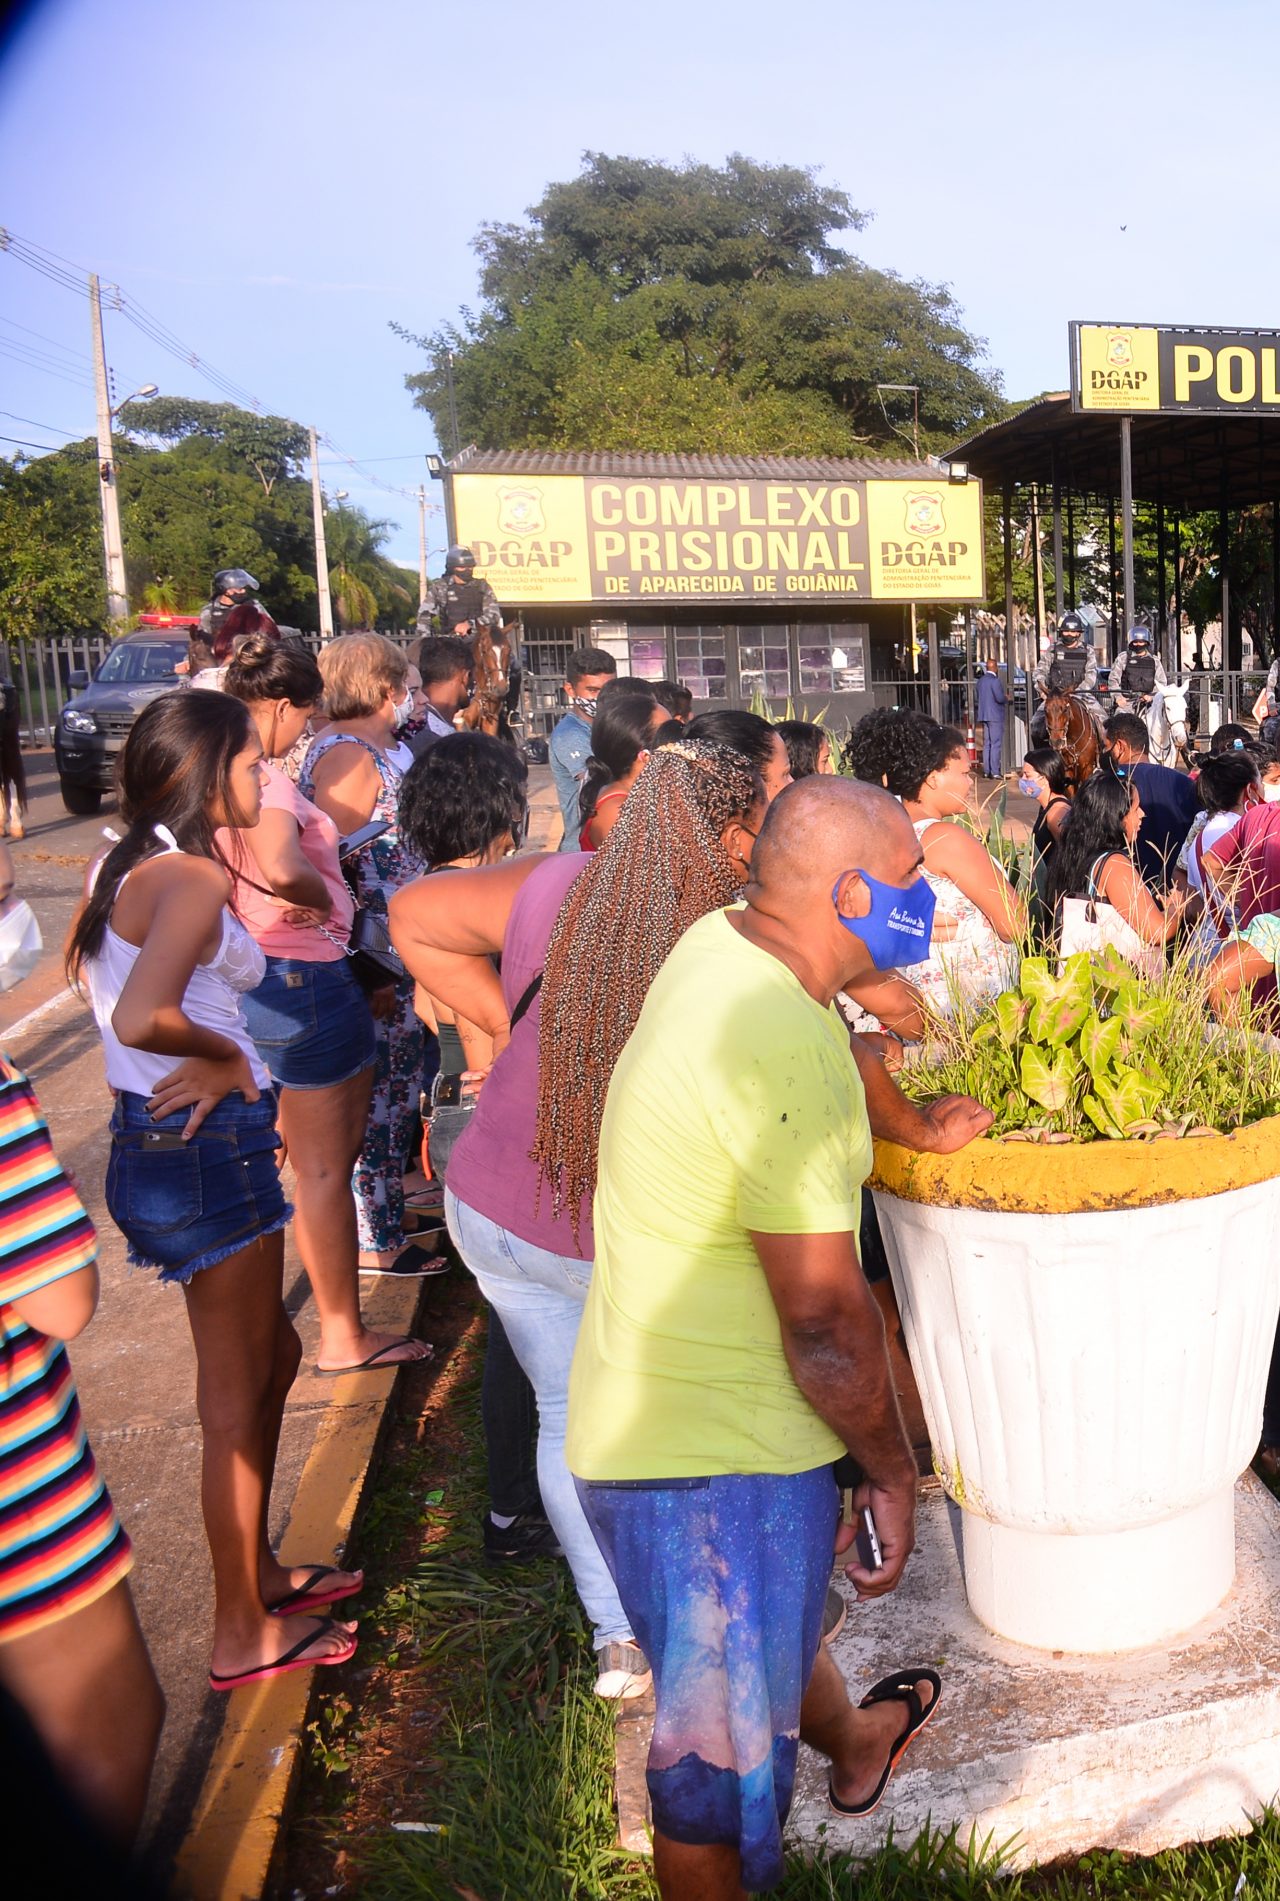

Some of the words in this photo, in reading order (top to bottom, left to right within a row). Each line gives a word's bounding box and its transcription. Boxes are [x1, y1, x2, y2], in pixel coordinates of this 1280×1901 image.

[1091, 370, 1148, 390] DGAP
[590, 484, 861, 527] COMPLEXO
[471, 540, 574, 568] DGAP
[594, 530, 865, 572] PRISIONAL
[881, 541, 968, 567] DGAP
[604, 576, 630, 594] DE
[640, 575, 744, 593] APARECIDA
[753, 575, 777, 592] DE
[786, 572, 859, 592] GOIÂNIA
[883, 574, 930, 582] ADMINISTRAÇÃO
